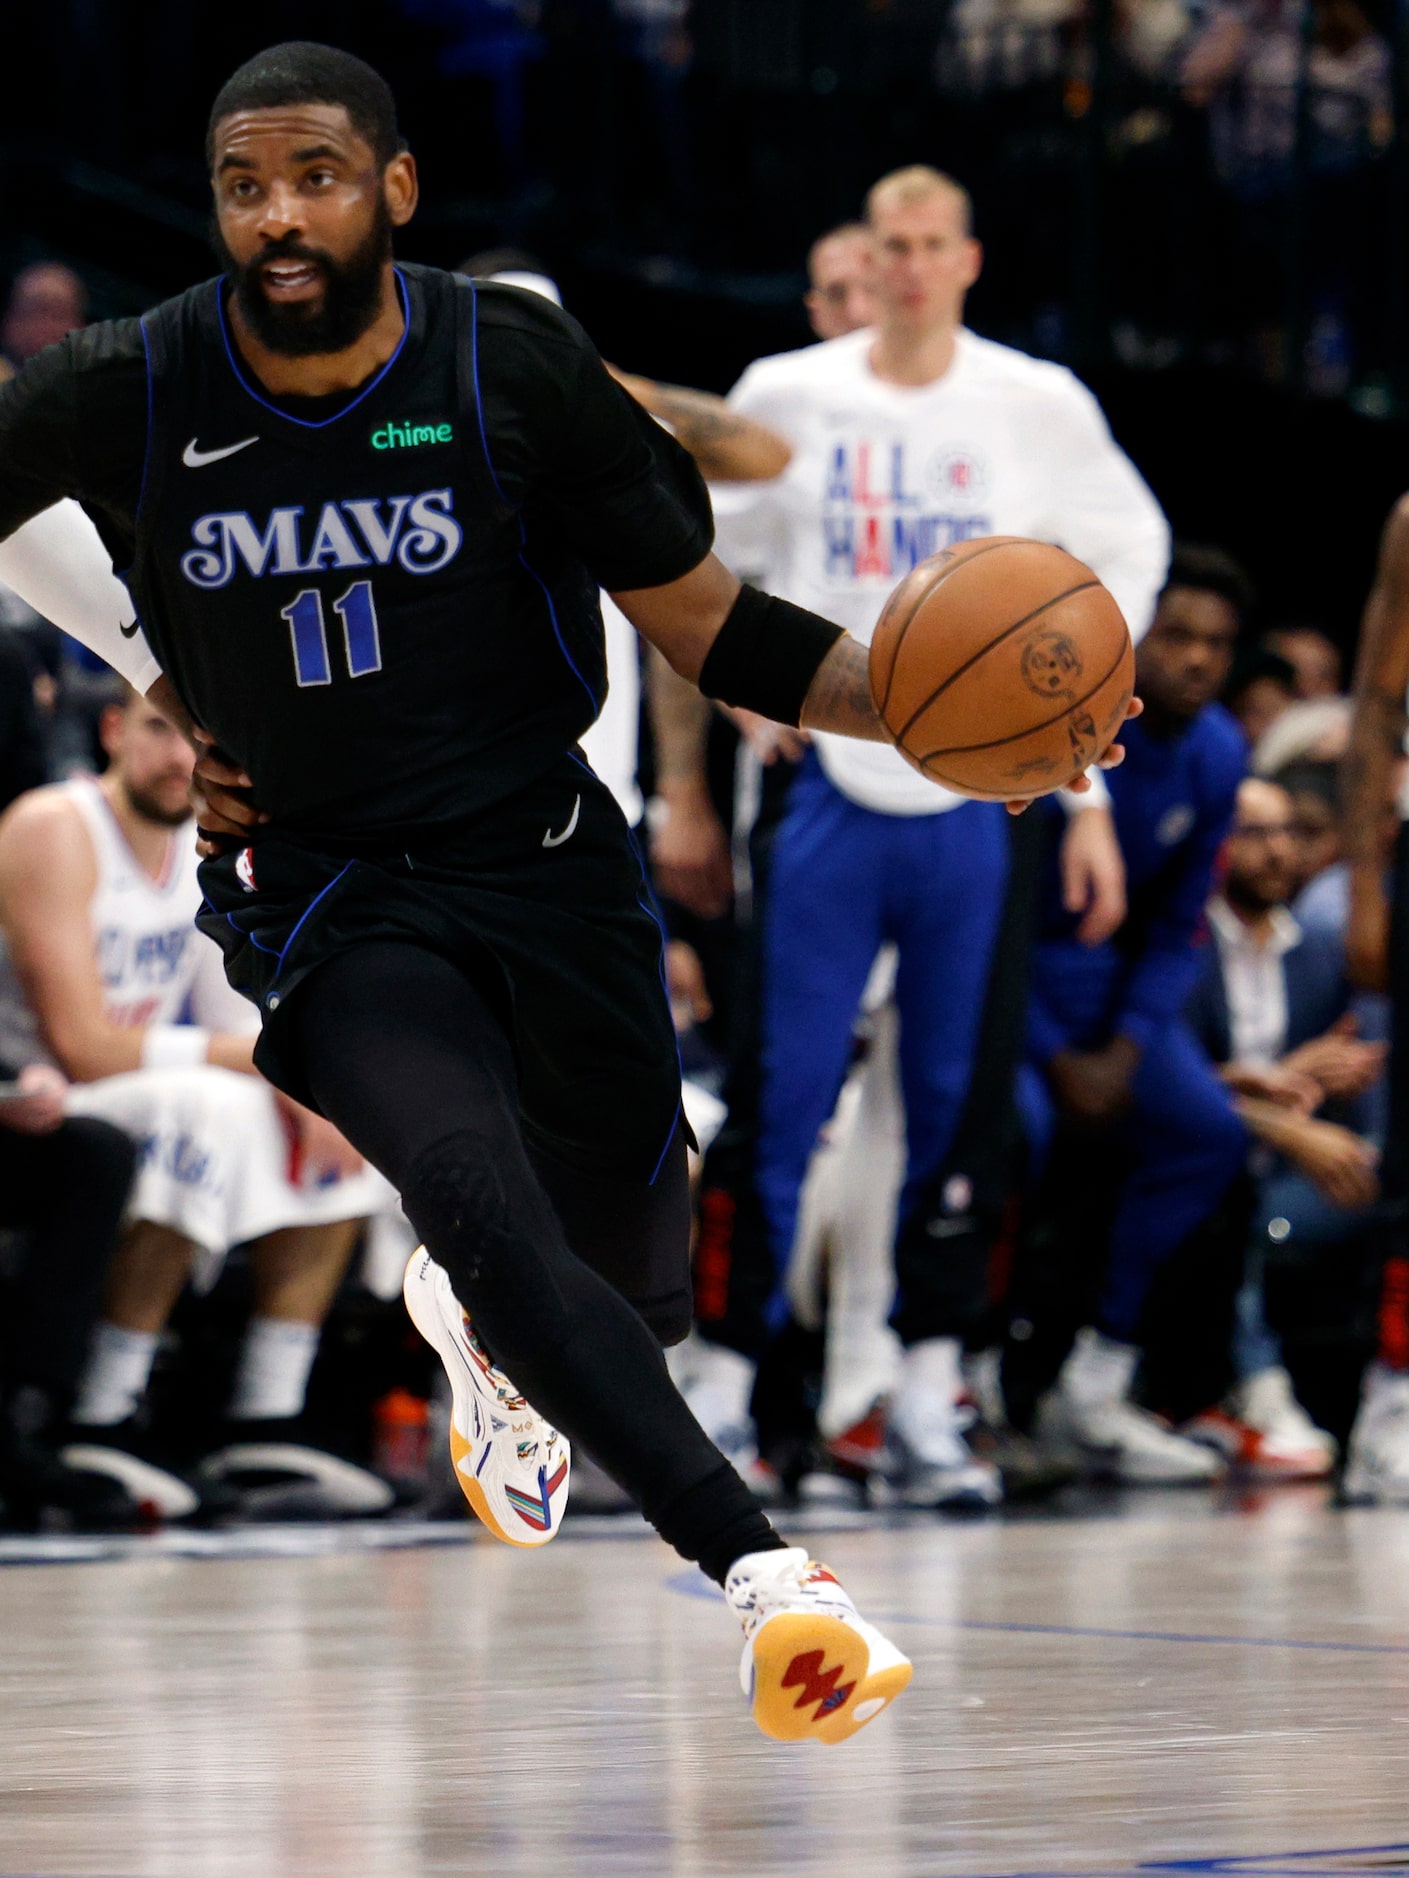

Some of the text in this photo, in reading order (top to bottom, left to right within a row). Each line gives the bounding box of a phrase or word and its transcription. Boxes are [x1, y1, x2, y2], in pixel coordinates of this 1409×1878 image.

[371, 421, 453, 450] chime
[823, 442, 922, 507] ALL
[180, 487, 463, 589] MAVS
[280, 580, 382, 687] 11
